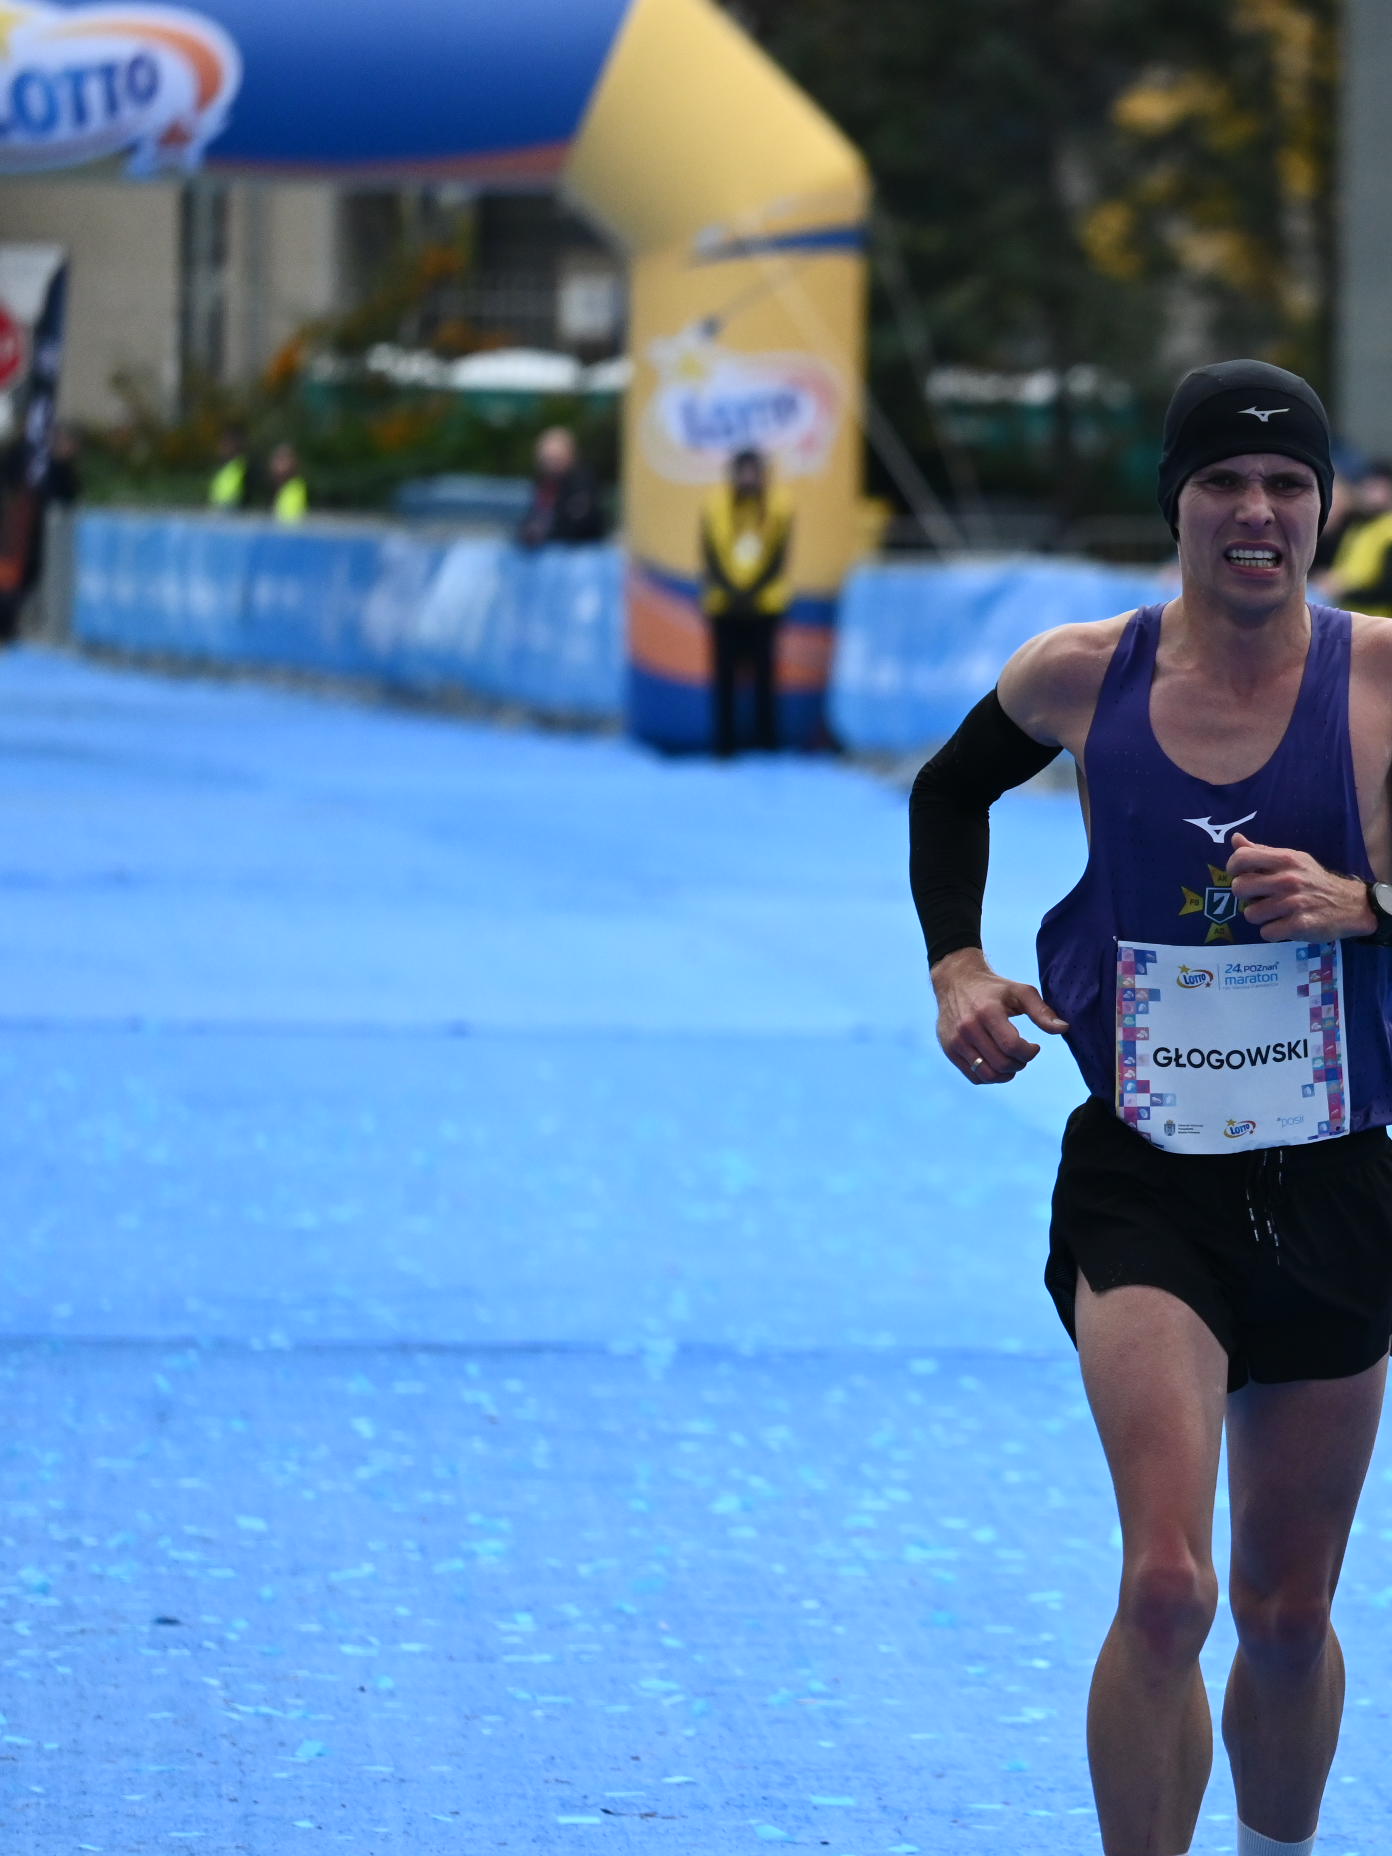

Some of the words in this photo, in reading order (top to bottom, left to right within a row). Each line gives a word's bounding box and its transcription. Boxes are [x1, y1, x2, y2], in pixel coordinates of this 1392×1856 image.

[0, 54, 159, 133] OTTO
[1213, 892, 1231, 915] 7
[1225, 973, 1278, 985] maraton
[1152, 1038, 1309, 1070] GŁOGOWSKI
